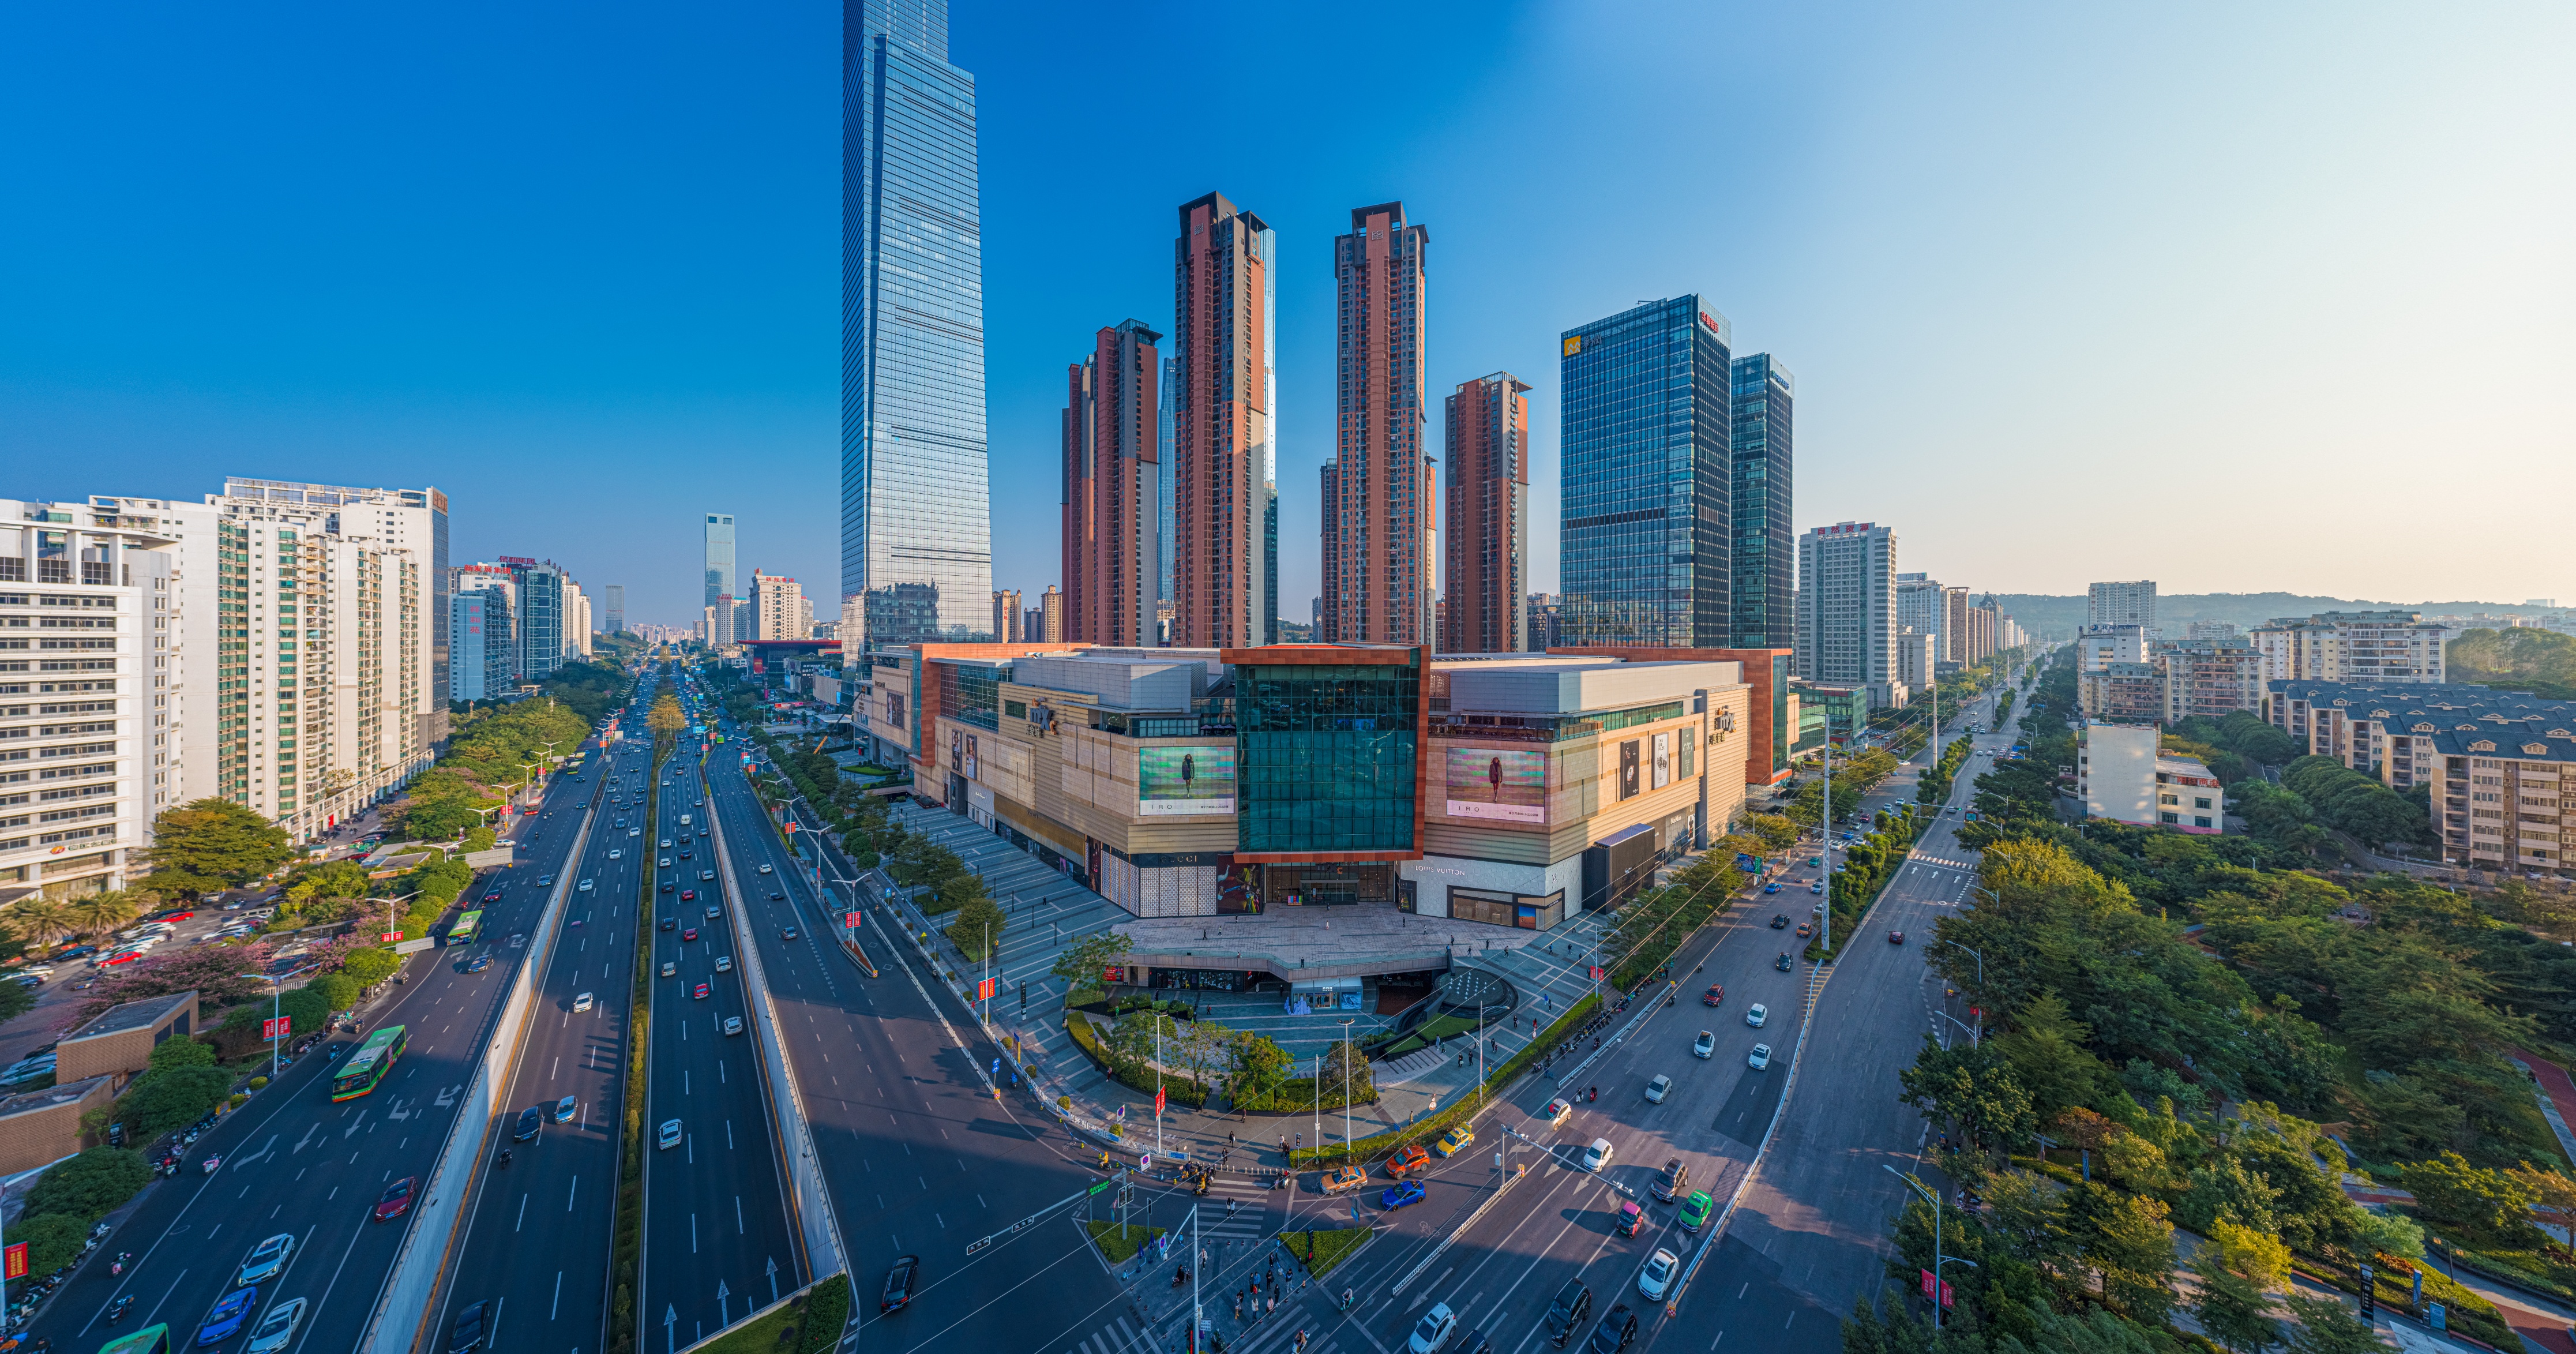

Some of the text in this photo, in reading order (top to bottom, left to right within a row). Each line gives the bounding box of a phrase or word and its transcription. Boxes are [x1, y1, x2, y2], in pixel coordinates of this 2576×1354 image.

[1702, 311, 1718, 333] 华夏银行
[1818, 523, 1869, 535] 自然资源
[500, 556, 535, 565] 荣和集团
[464, 564, 512, 574] 新发展集团
[470, 606, 480, 633] 祥和苑
[1160, 855, 1197, 863] GUCCI
[1436, 868, 1465, 876] VUITTON
